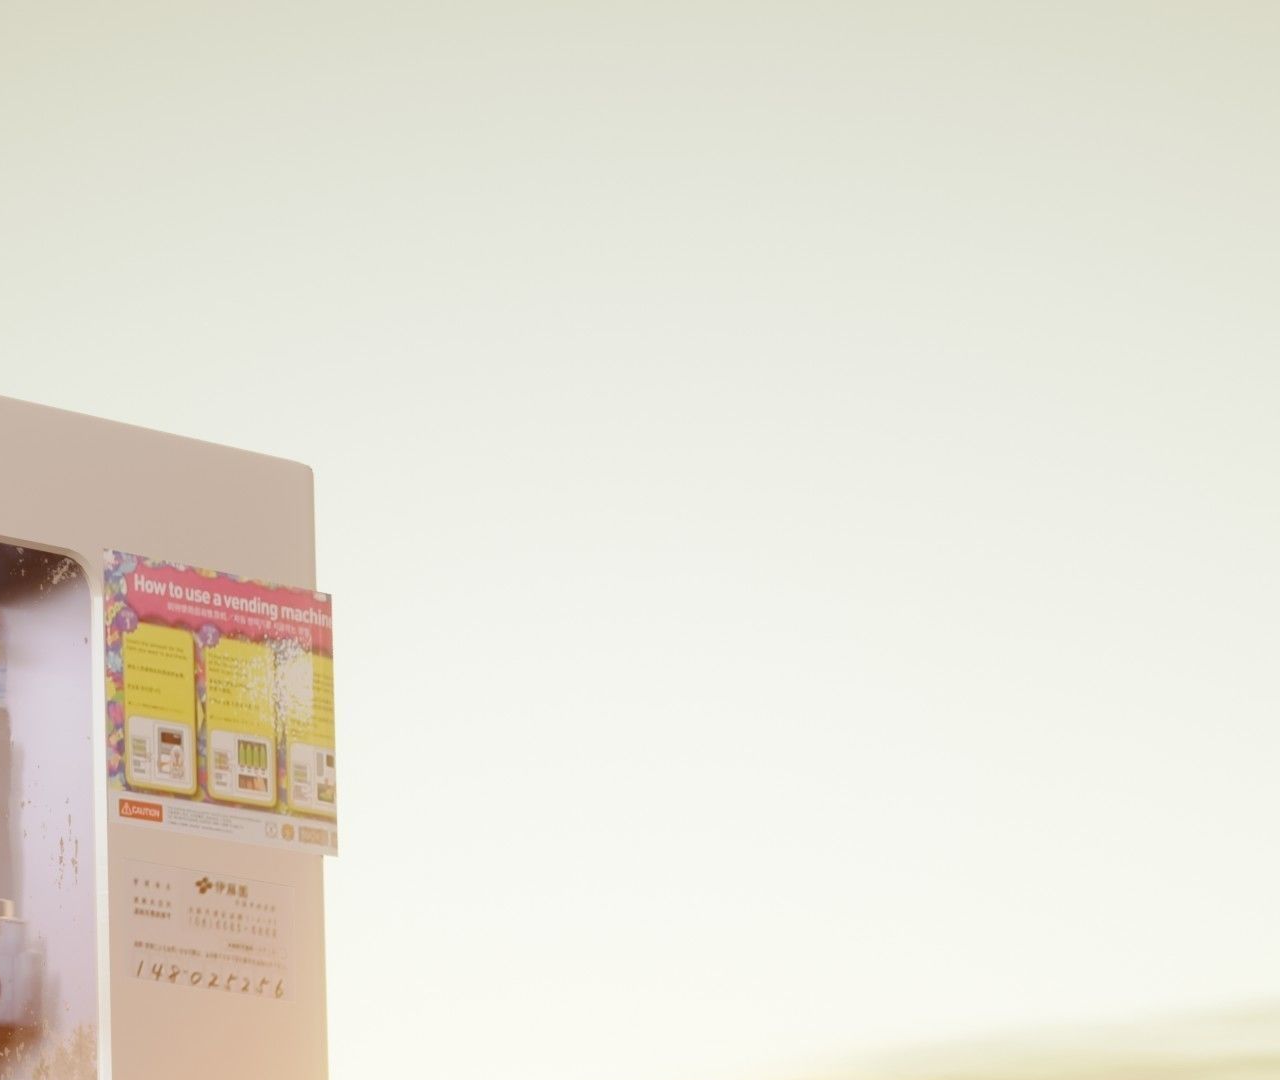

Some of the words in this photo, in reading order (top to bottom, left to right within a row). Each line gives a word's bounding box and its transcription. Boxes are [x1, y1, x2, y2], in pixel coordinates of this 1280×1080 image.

[134, 574, 167, 595] How
[169, 582, 183, 598] to
[185, 587, 211, 605] use
[213, 594, 222, 606] a
[224, 594, 278, 619] vending
